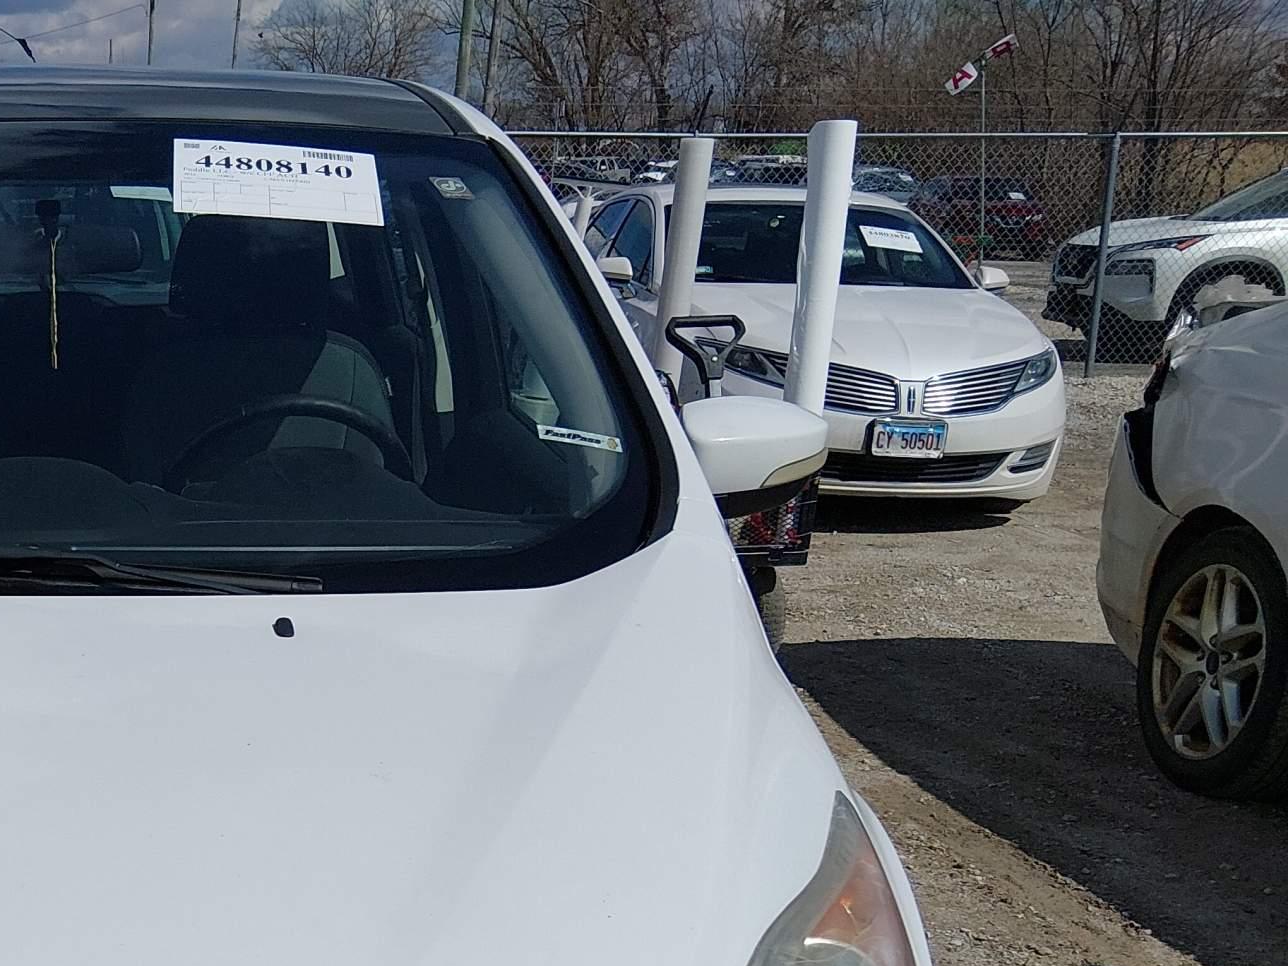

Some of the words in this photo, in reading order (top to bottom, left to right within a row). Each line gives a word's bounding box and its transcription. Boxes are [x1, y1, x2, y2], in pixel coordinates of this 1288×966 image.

[195, 154, 353, 179] 44808140
[876, 430, 894, 449] CY
[900, 431, 942, 451] 50501
